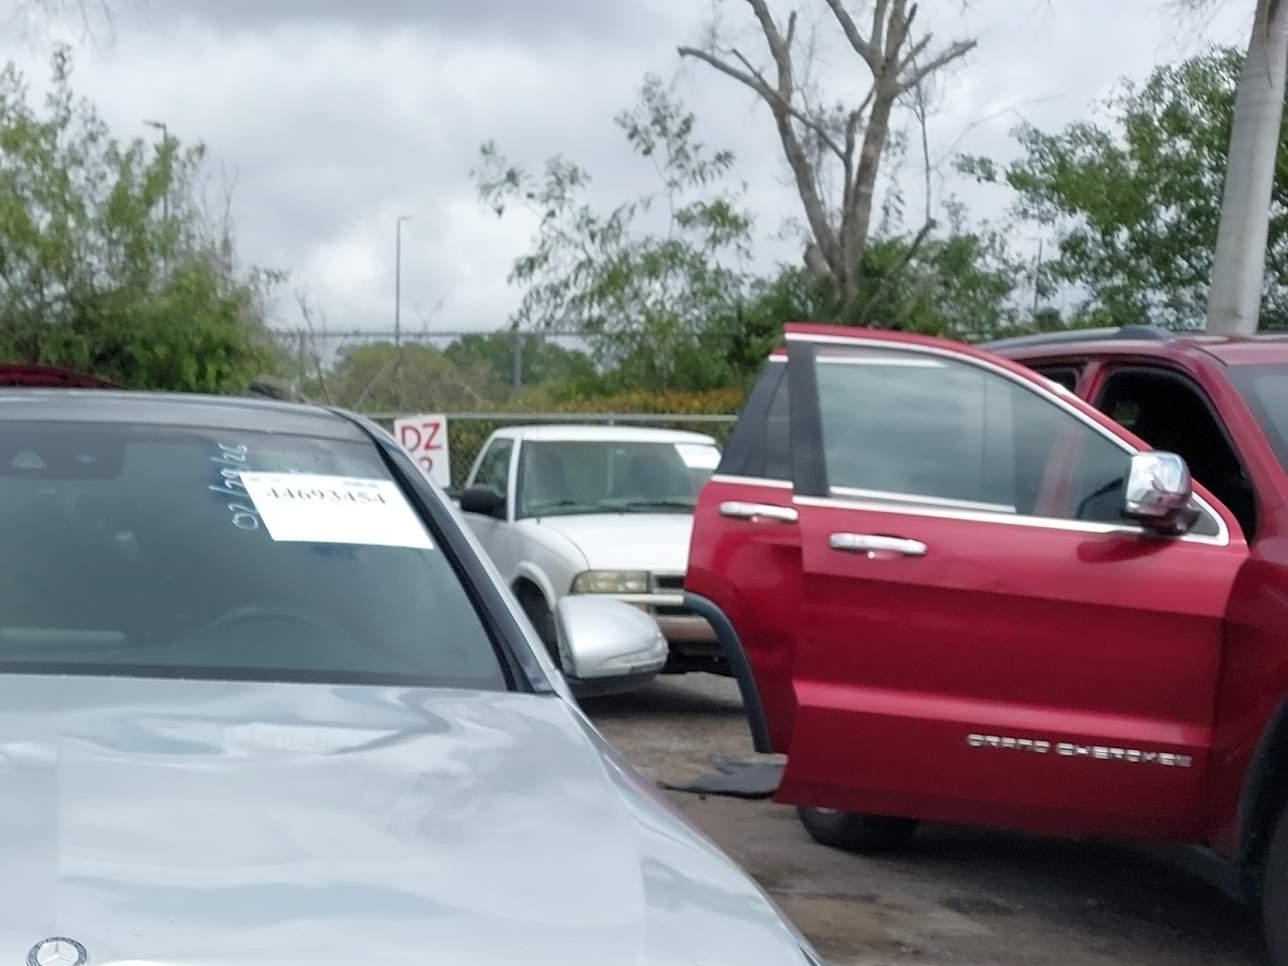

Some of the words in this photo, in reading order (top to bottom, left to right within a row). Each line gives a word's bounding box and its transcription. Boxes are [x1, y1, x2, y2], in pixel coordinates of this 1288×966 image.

[399, 422, 442, 452] DZ
[967, 733, 1050, 753] GRAND
[1056, 743, 1193, 767] CHEROKEE
